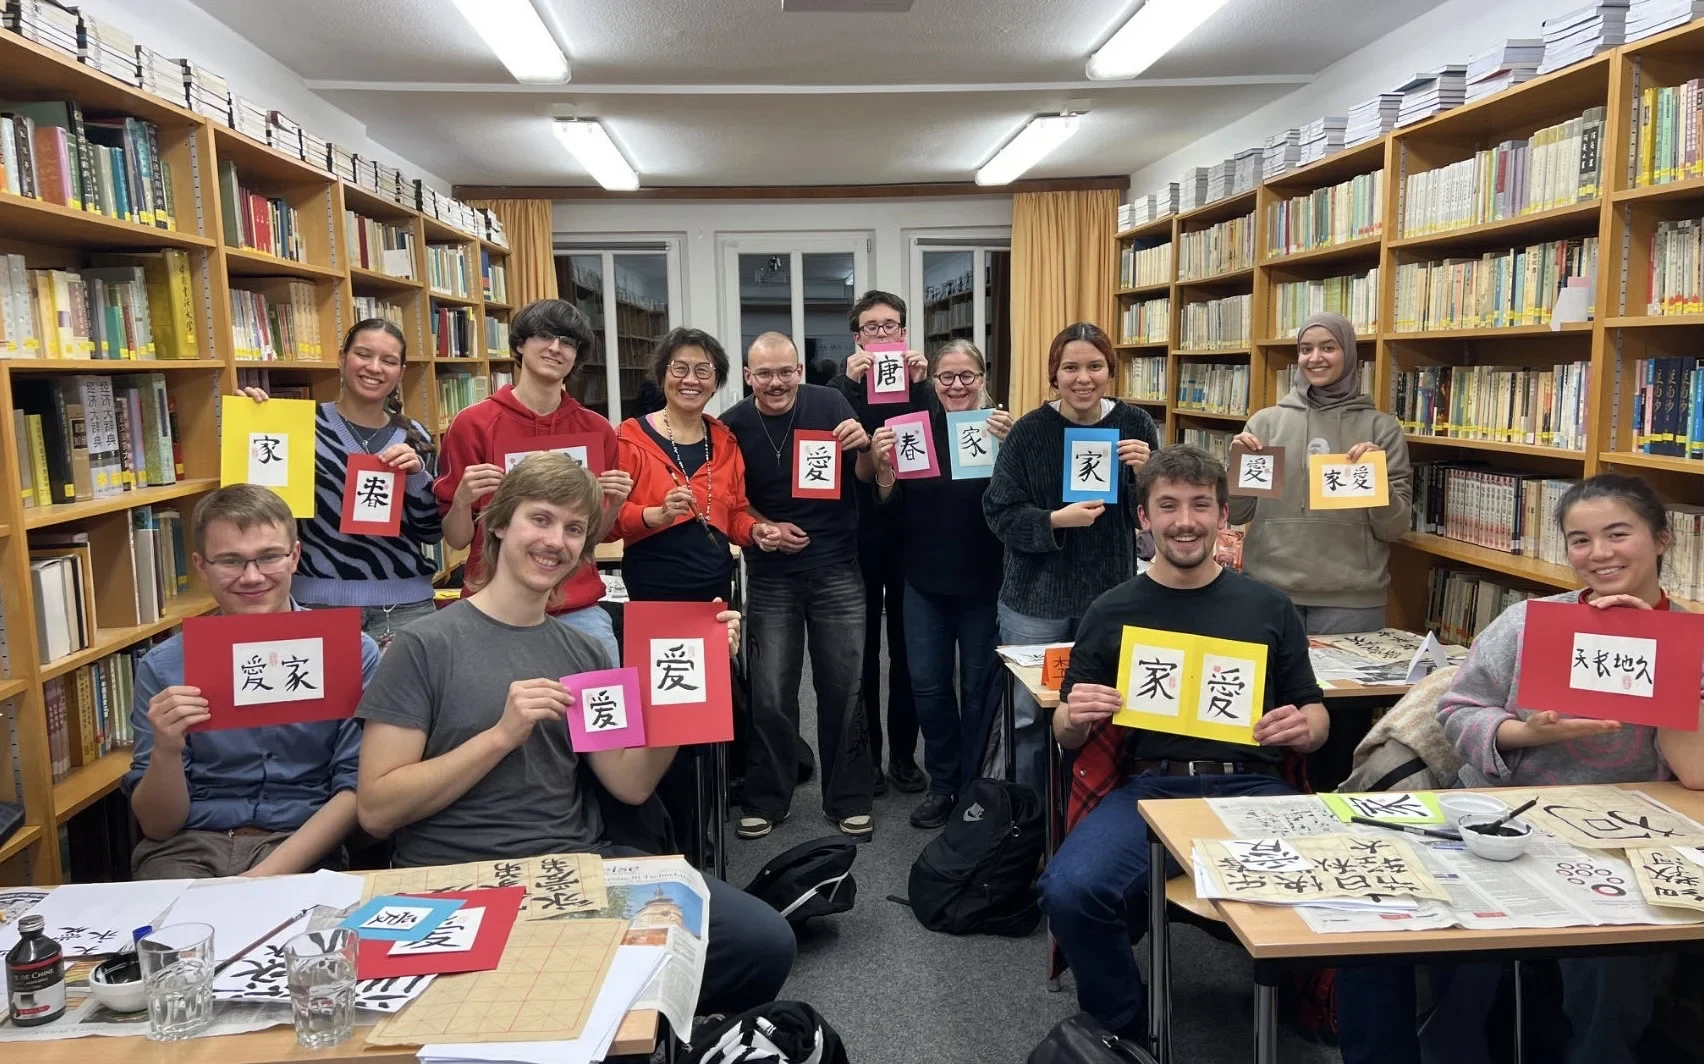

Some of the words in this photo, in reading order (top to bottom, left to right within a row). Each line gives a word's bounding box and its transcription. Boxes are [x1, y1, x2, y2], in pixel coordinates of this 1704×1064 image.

[877, 355, 903, 388] 唐
[253, 435, 284, 464] 家
[900, 432, 926, 461] 春
[959, 426, 987, 458] 家
[1075, 450, 1106, 483] 家
[357, 476, 389, 509] 春
[656, 644, 700, 691] 爱
[1136, 656, 1178, 700] 家
[590, 690, 619, 728] 爱
